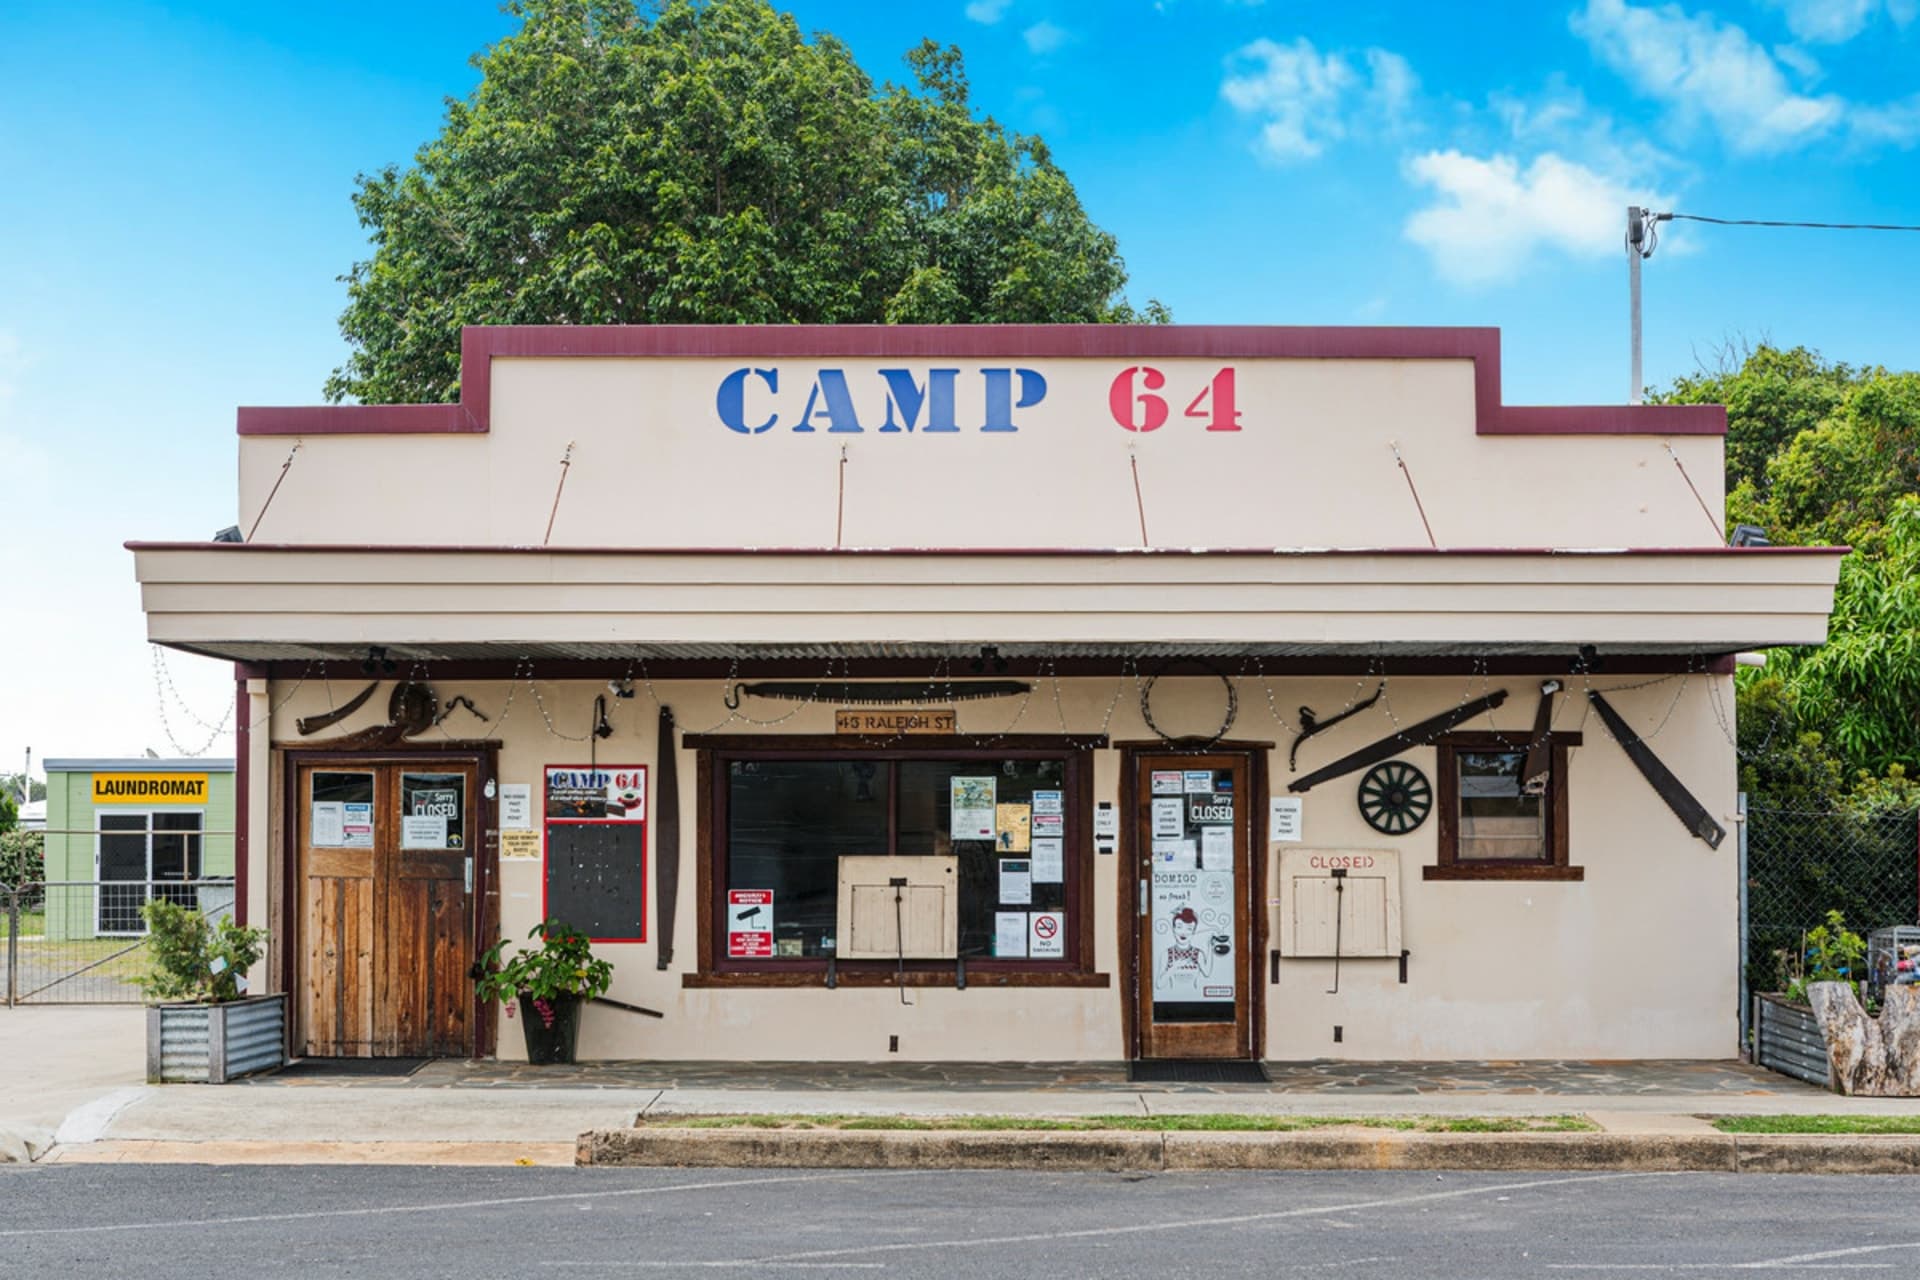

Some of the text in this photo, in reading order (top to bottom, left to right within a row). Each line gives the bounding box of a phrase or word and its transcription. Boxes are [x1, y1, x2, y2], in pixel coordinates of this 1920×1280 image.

[716, 366, 1243, 434] CAMP 64
[865, 715, 929, 729] RALEIGH
[935, 716, 953, 729] ST
[552, 772, 641, 789] CAMP 64
[95, 780, 204, 796] LAUNDROMAT
[434, 792, 454, 802] Sorry
[1212, 794, 1233, 806] Sorry
[415, 802, 456, 817] CLOSED
[1191, 806, 1234, 820] CLOSED
[1310, 855, 1375, 869] CLOSED
